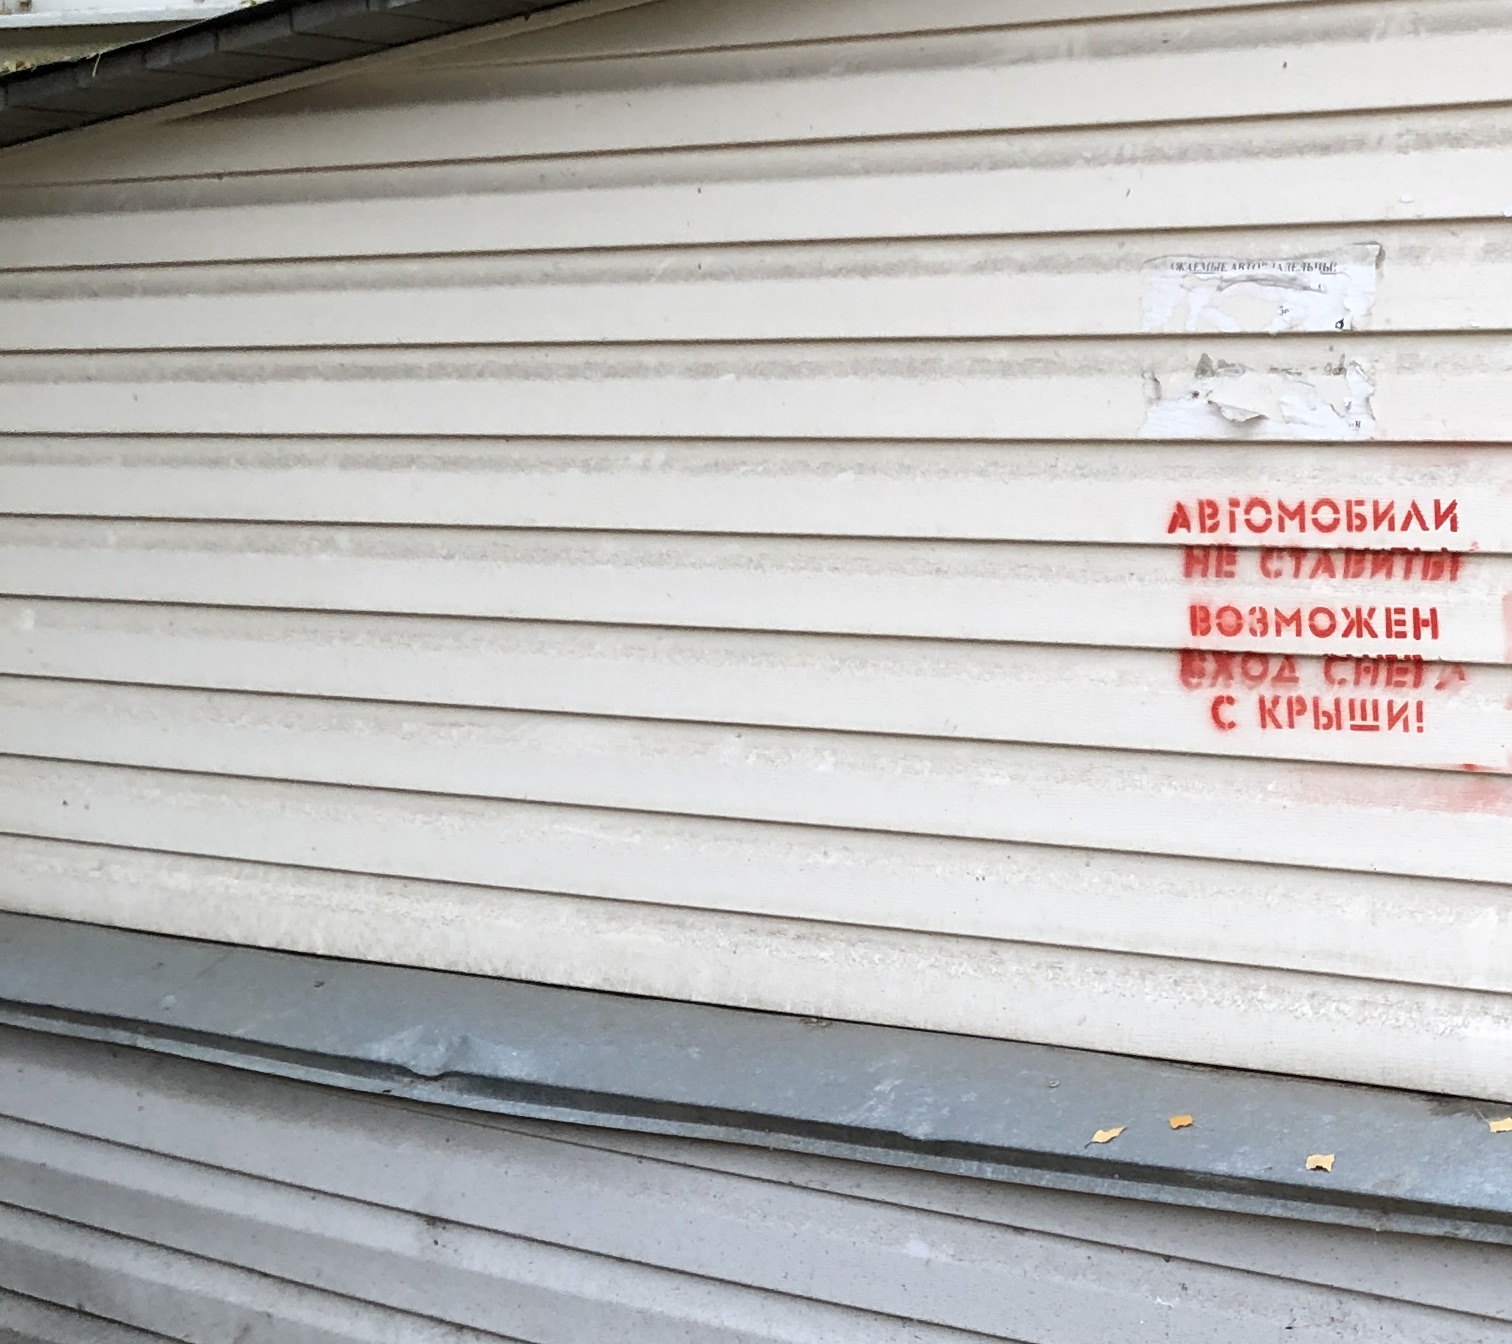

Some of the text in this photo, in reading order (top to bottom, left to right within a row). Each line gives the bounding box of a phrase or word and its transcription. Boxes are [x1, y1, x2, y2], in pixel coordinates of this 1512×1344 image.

[1167, 497, 1460, 534] АВТОМОБИЛИ
[1182, 544, 1238, 579] НЕ
[1189, 605, 1440, 640] ВОЗМОЖЕН
[1210, 694, 1425, 734] С КРЫШИ!
